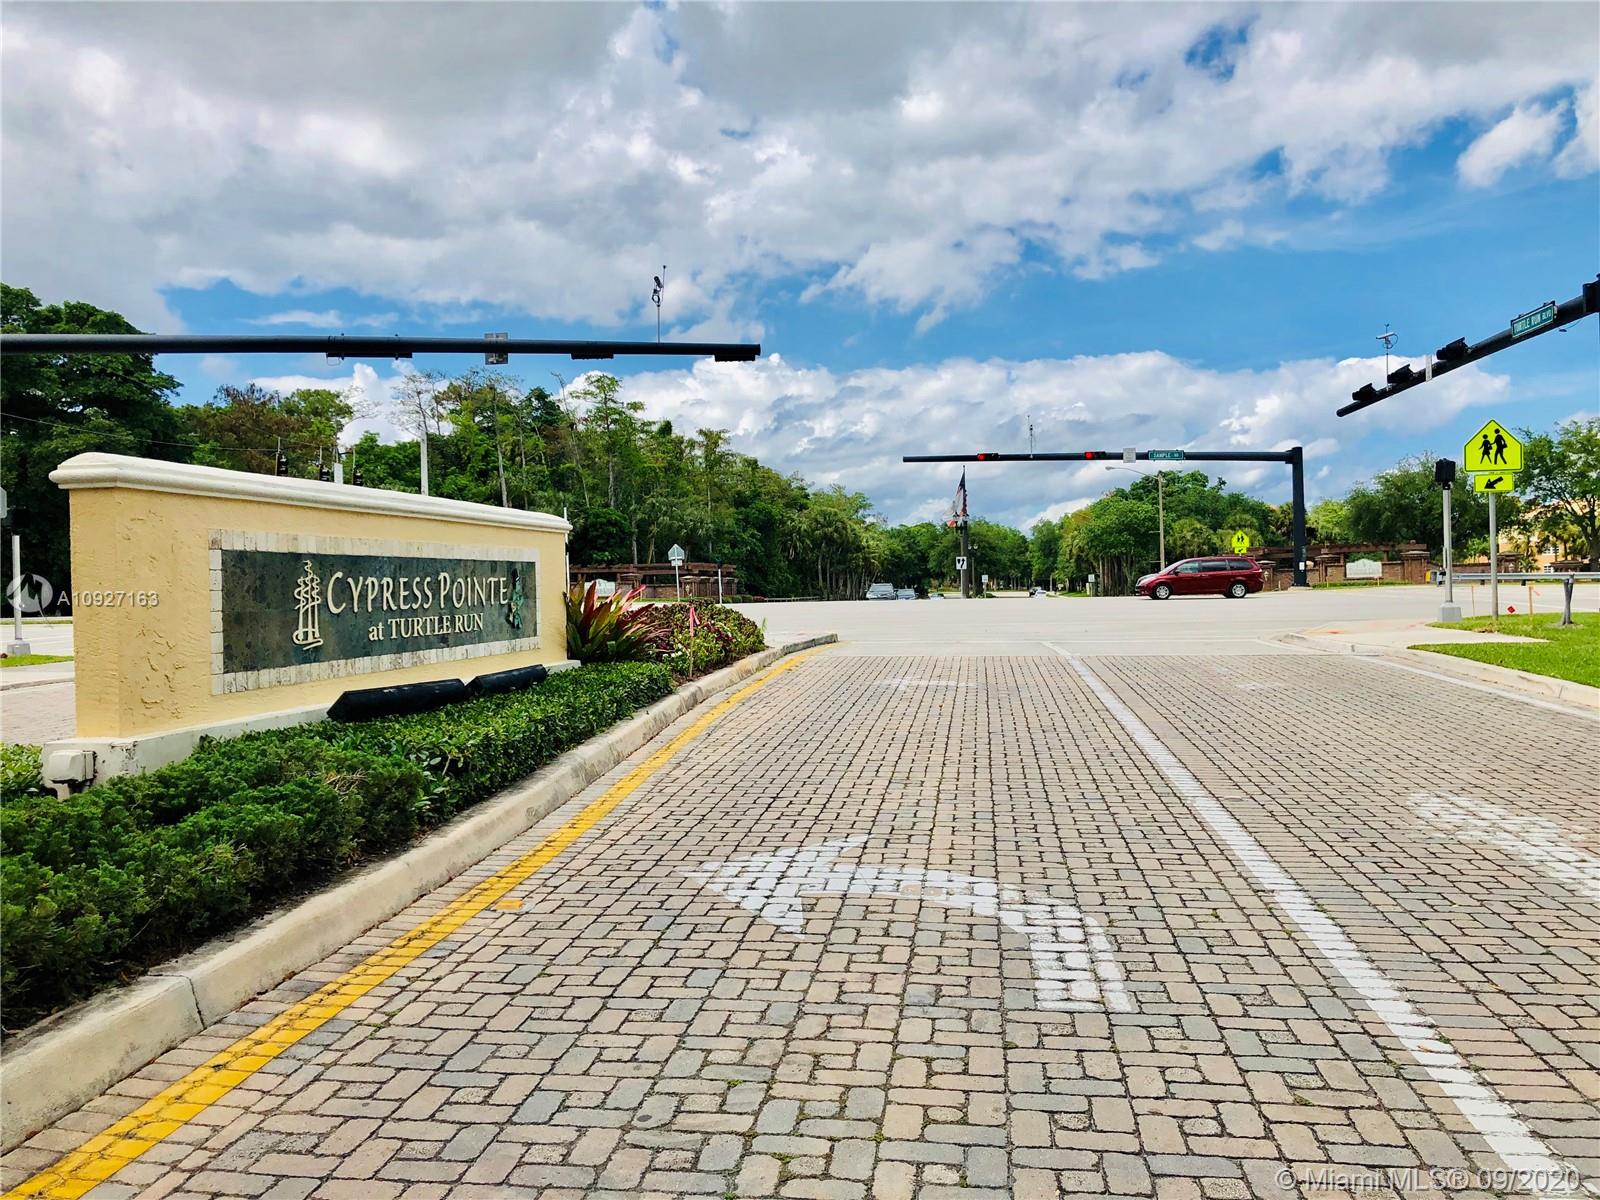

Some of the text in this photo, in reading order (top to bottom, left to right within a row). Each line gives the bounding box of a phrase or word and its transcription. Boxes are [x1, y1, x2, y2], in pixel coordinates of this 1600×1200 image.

[326, 571, 509, 615] CYPRESS POINTE
[368, 612, 485, 641] at TURTLE RUN
